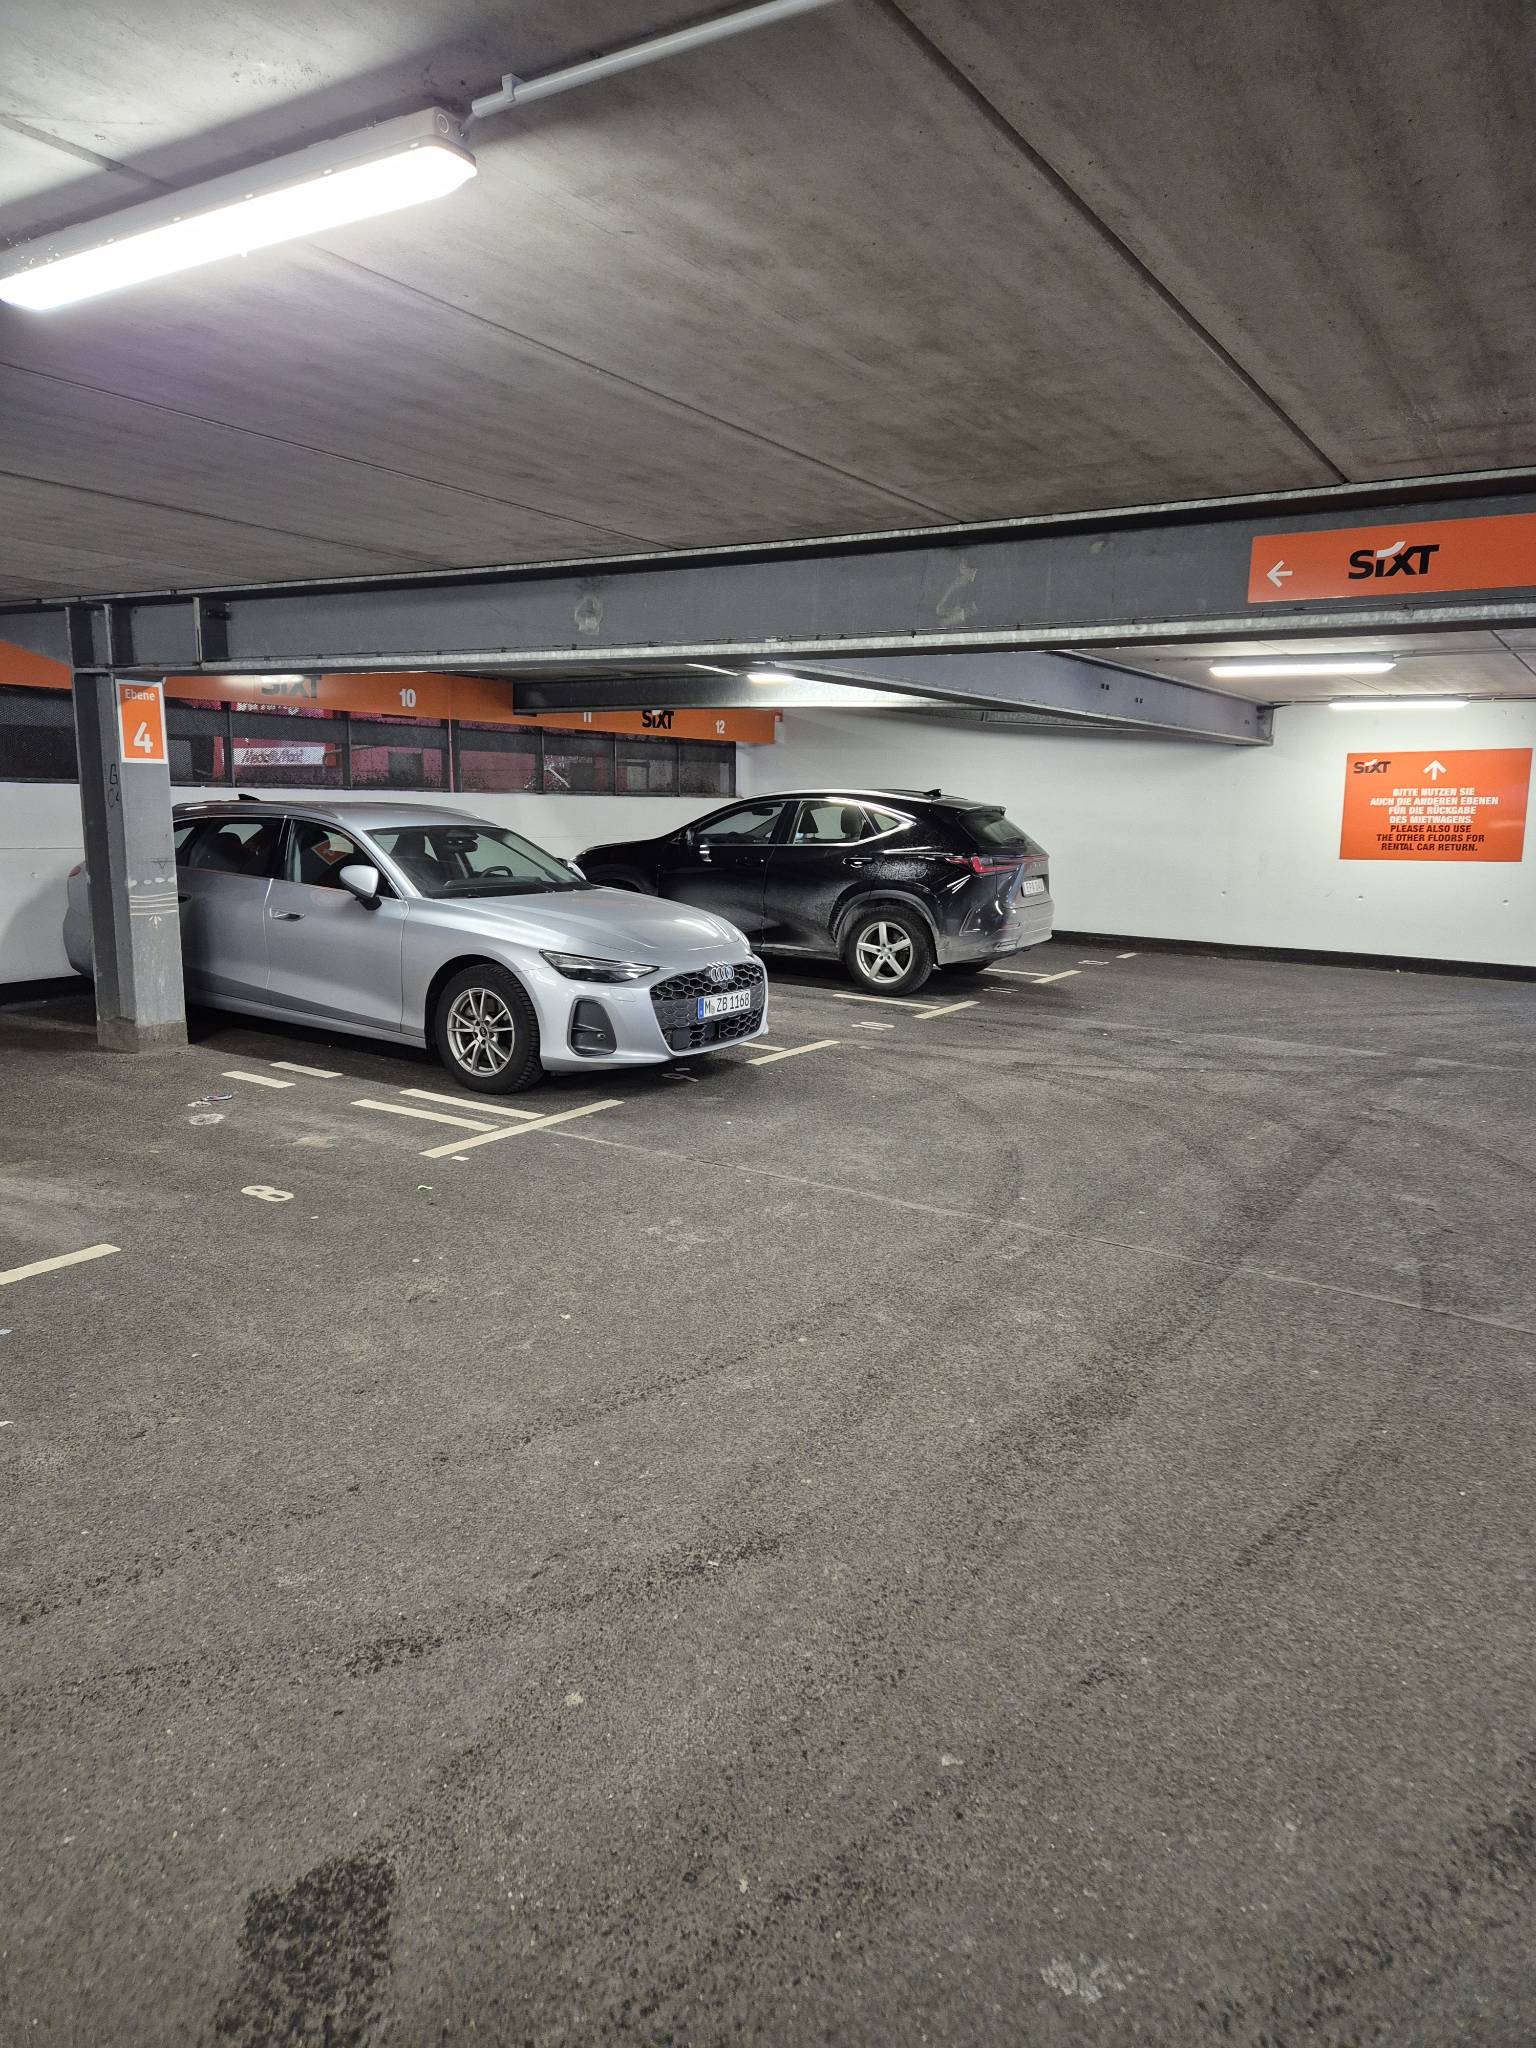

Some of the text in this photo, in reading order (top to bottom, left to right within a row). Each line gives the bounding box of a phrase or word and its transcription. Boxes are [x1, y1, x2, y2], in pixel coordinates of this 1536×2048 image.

[1348, 541, 1440, 579] SIXT
[124, 687, 156, 701] Ebene
[399, 688, 416, 708] 10
[642, 709, 675, 730] SIXT
[715, 719, 725, 735] 12
[133, 721, 154, 754] 4
[1353, 759, 1391, 774] SIXT
[1392, 787, 1475, 796] BITTE NUTZEN SIE
[1370, 797, 1498, 806] AUCH DIE ANDEREN EBENEN
[1388, 804, 1476, 814] FÜR DIE RÜCKGABE
[1389, 815, 1474, 824] DES MIETWAGENS.
[1390, 825, 1472, 833] PLEASE ALSO USE
[1377, 834, 1485, 842] THE OTHER FLOORS FOR
[1381, 843, 1478, 851] RENTAL CAR RETURN.
[704, 992, 750, 1014] M ZB 1168
[241, 1185, 294, 1202] 8
